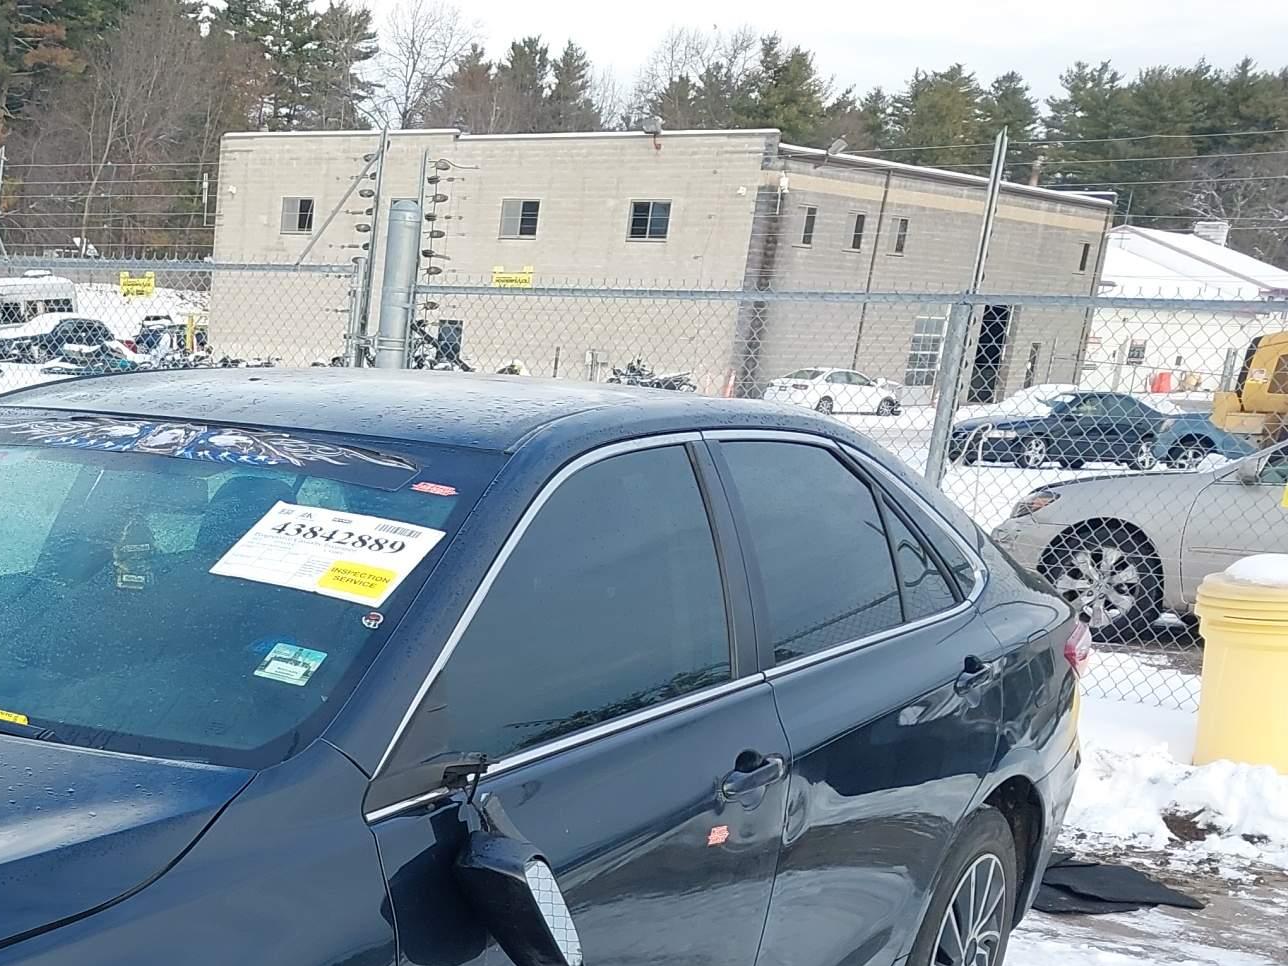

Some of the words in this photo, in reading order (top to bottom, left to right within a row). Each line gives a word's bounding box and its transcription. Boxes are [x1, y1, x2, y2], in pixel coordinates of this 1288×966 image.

[272, 522, 405, 553] 43842889
[332, 567, 390, 583] INSPECTION
[334, 576, 378, 590] SERVICE
